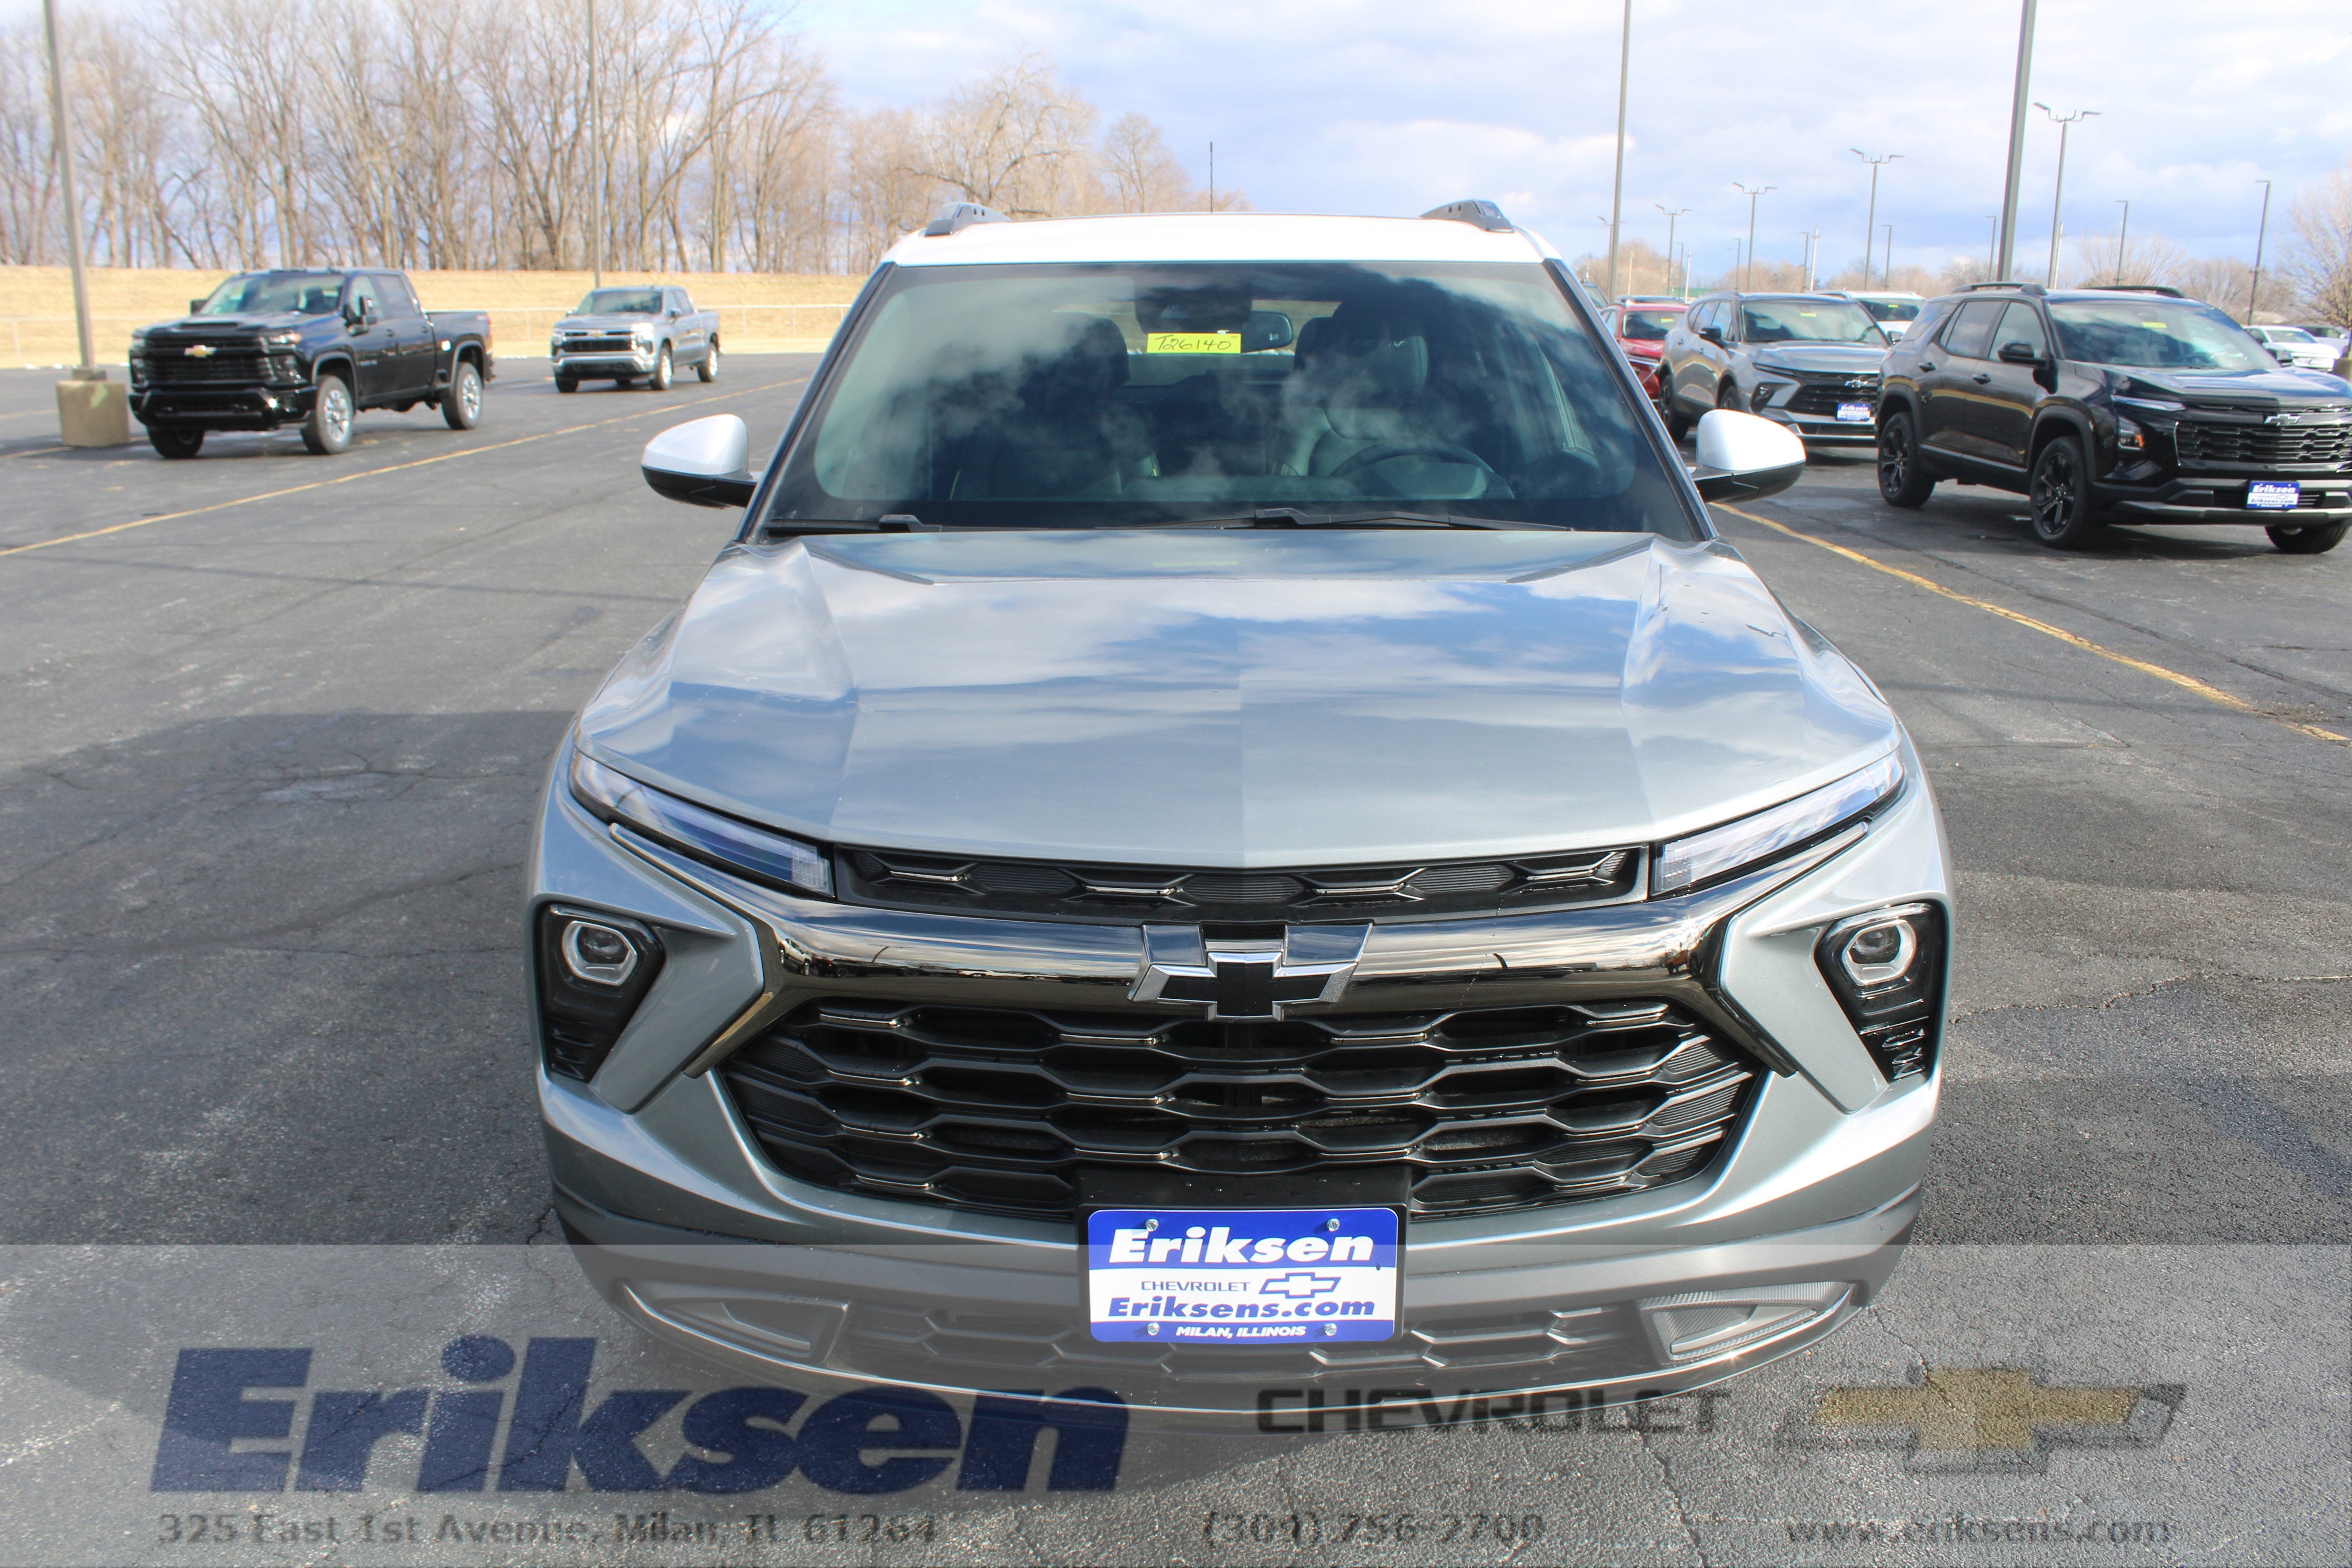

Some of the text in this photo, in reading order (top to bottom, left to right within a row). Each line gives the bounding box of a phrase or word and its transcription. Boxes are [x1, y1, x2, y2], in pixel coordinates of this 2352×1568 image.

[1154, 334, 1232, 352] T26140
[2252, 484, 2296, 493] Eriksen
[1109, 1226, 1374, 1264] Eriksen
[1141, 1281, 1252, 1292] CHEVROLET
[1108, 1296, 1375, 1318] Eriksens.com
[1176, 1325, 1307, 1339] MILAN, ILLINOIS
